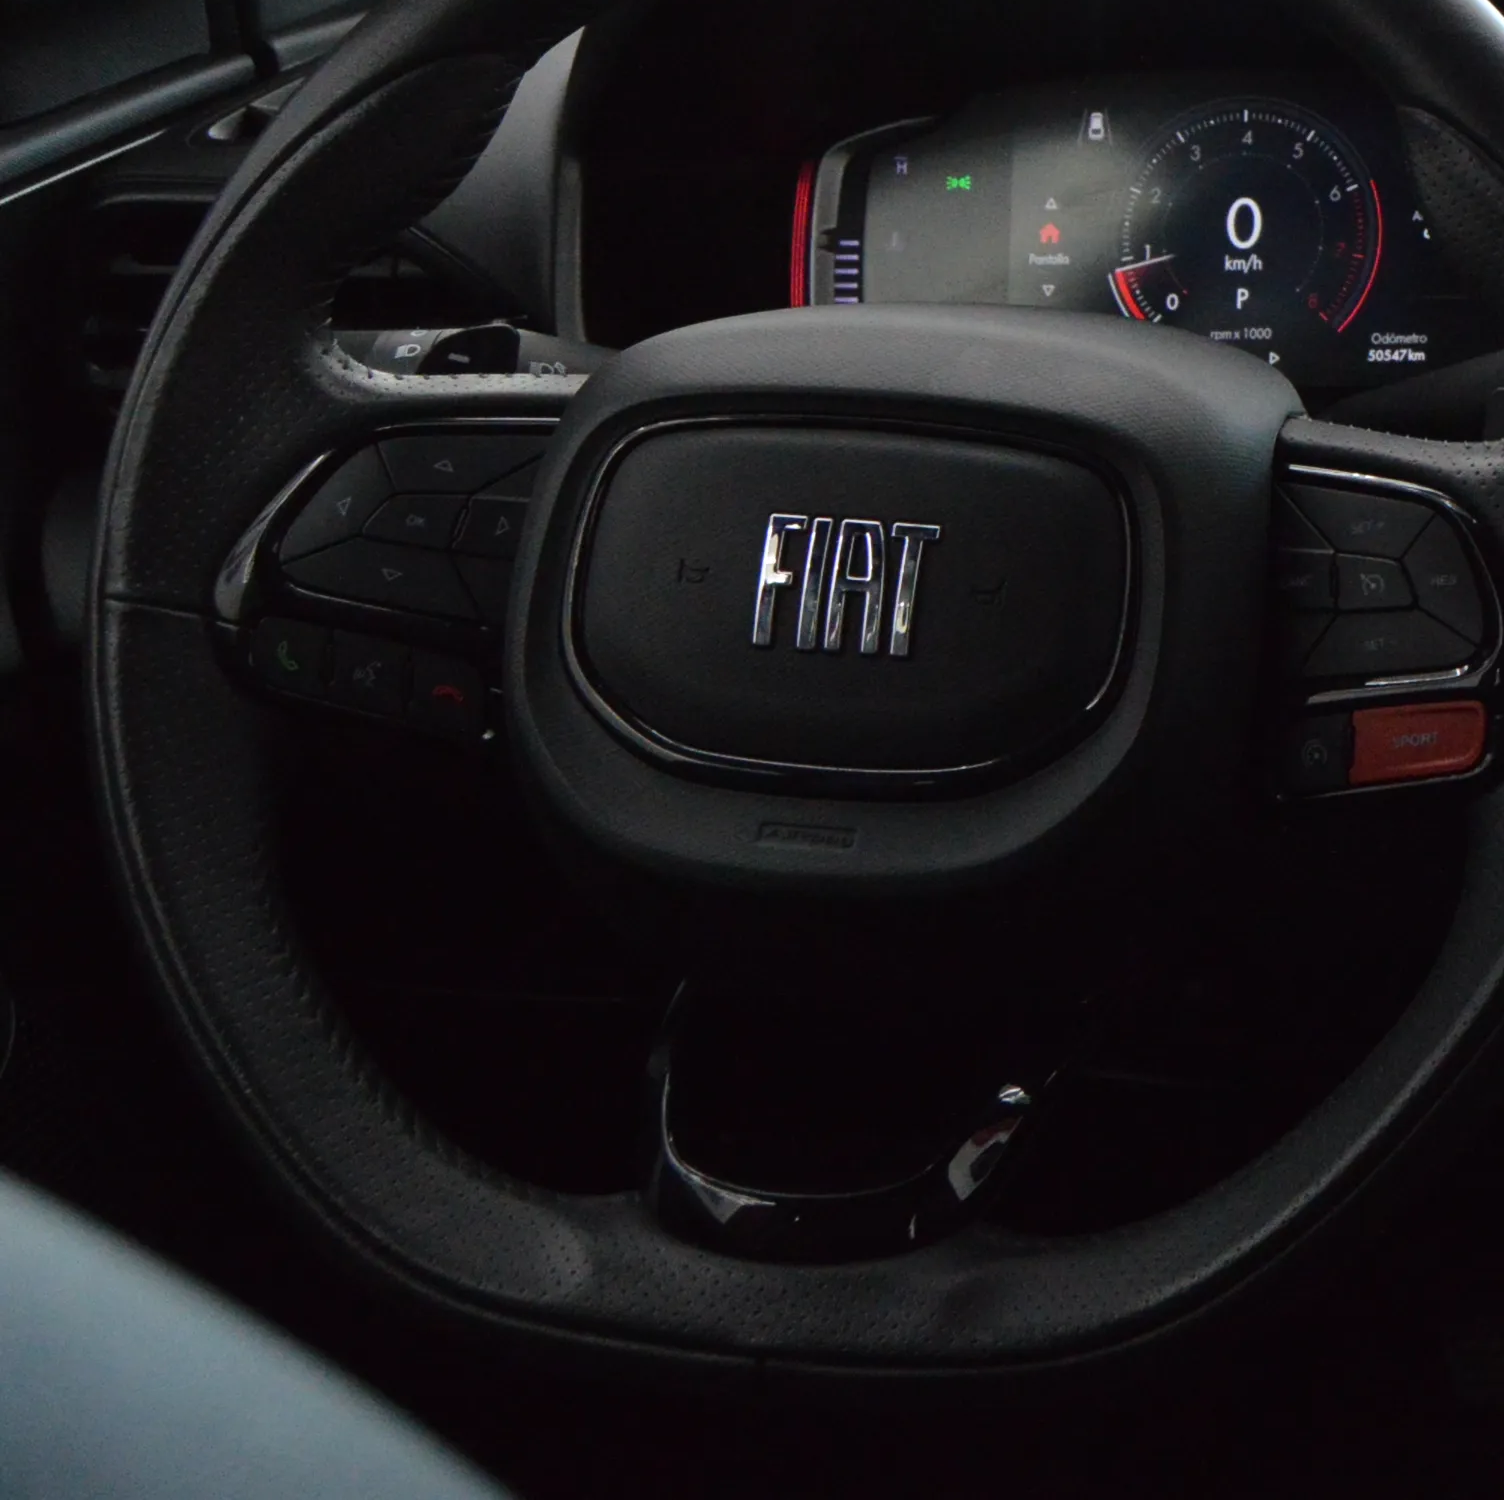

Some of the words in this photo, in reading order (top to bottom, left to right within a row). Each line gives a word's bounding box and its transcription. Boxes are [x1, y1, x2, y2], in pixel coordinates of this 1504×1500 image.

[1243, 131, 1252, 144] 4
[1190, 146, 1200, 161] 3
[1293, 143, 1303, 158] 5
[1330, 186, 1341, 201] 6
[1227, 198, 1262, 249] 0
[1225, 254, 1262, 273] km/h
[1166, 294, 1178, 310] 0
[1236, 288, 1248, 309] P
[1210, 330, 1233, 342] rpm
[1243, 327, 1273, 340] 1000
[1371, 333, 1427, 344] Odómetro
[1367, 350, 1406, 362] 50547
[752, 512, 942, 657] FIAT
[1393, 732, 1439, 748] SPORT
